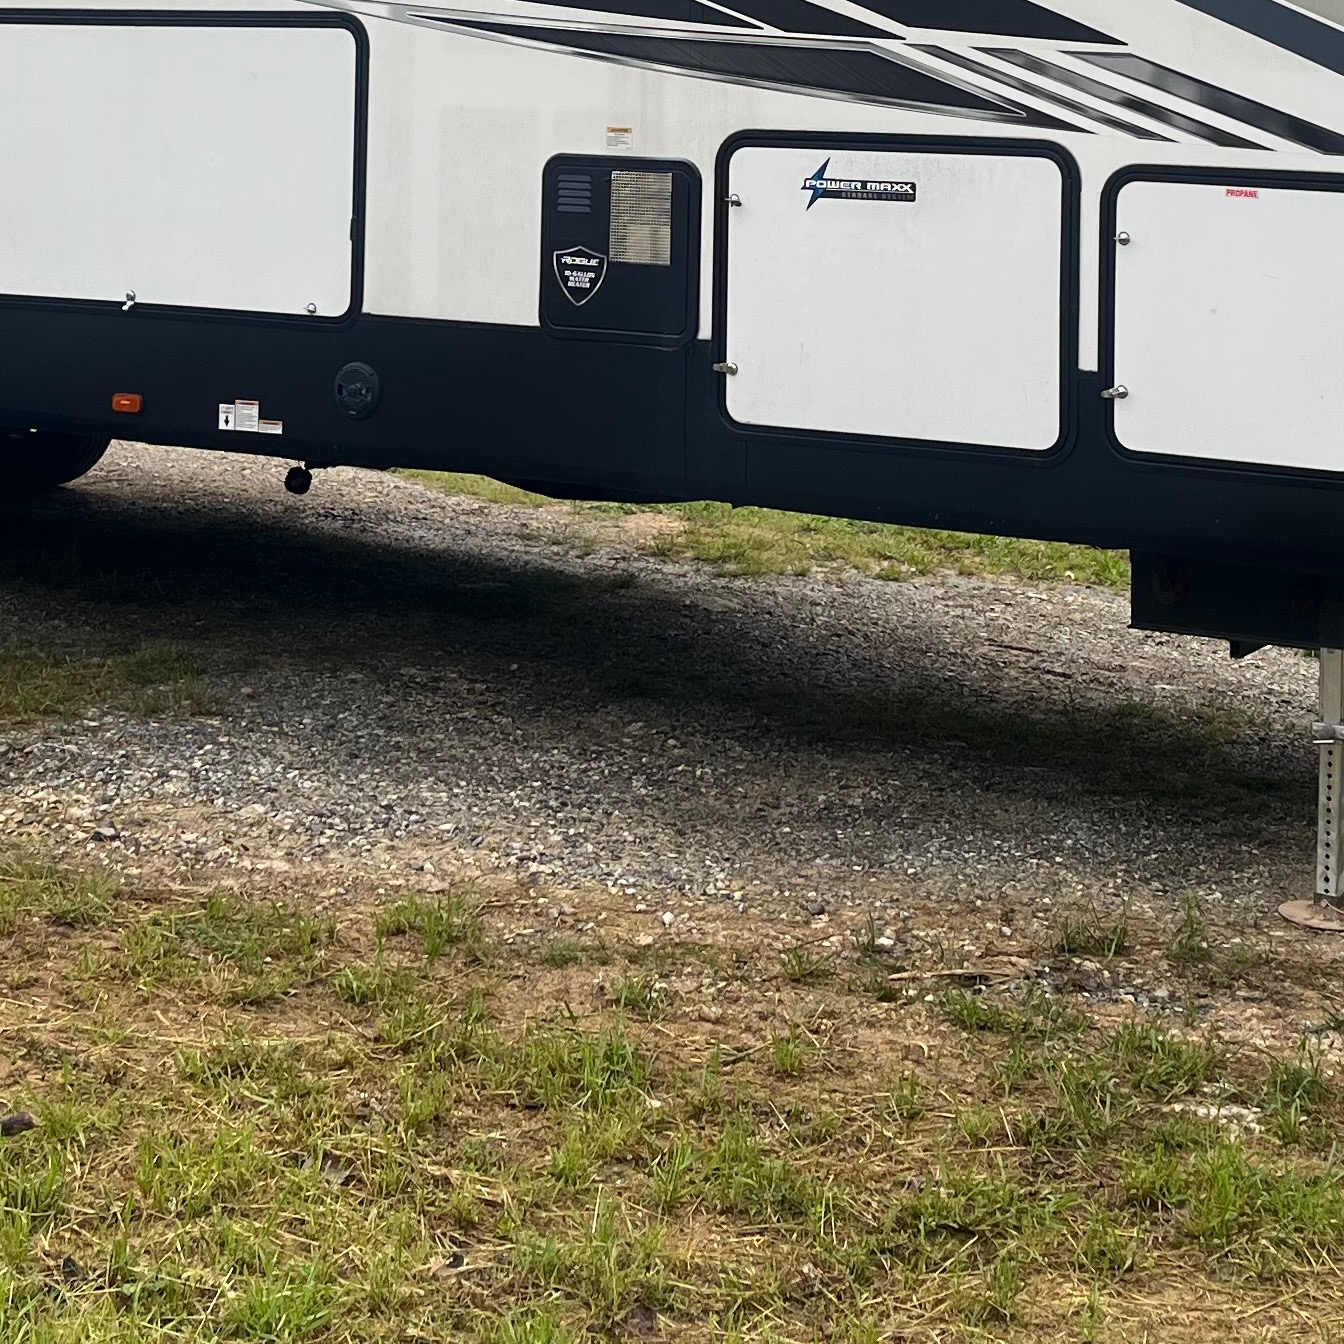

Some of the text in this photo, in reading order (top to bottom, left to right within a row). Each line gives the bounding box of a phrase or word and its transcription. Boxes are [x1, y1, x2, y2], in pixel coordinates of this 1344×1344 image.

[805, 179, 915, 194] POWER MAXX
[1226, 188, 1258, 198] PROPANE
[560, 255, 600, 266] ROGUE
